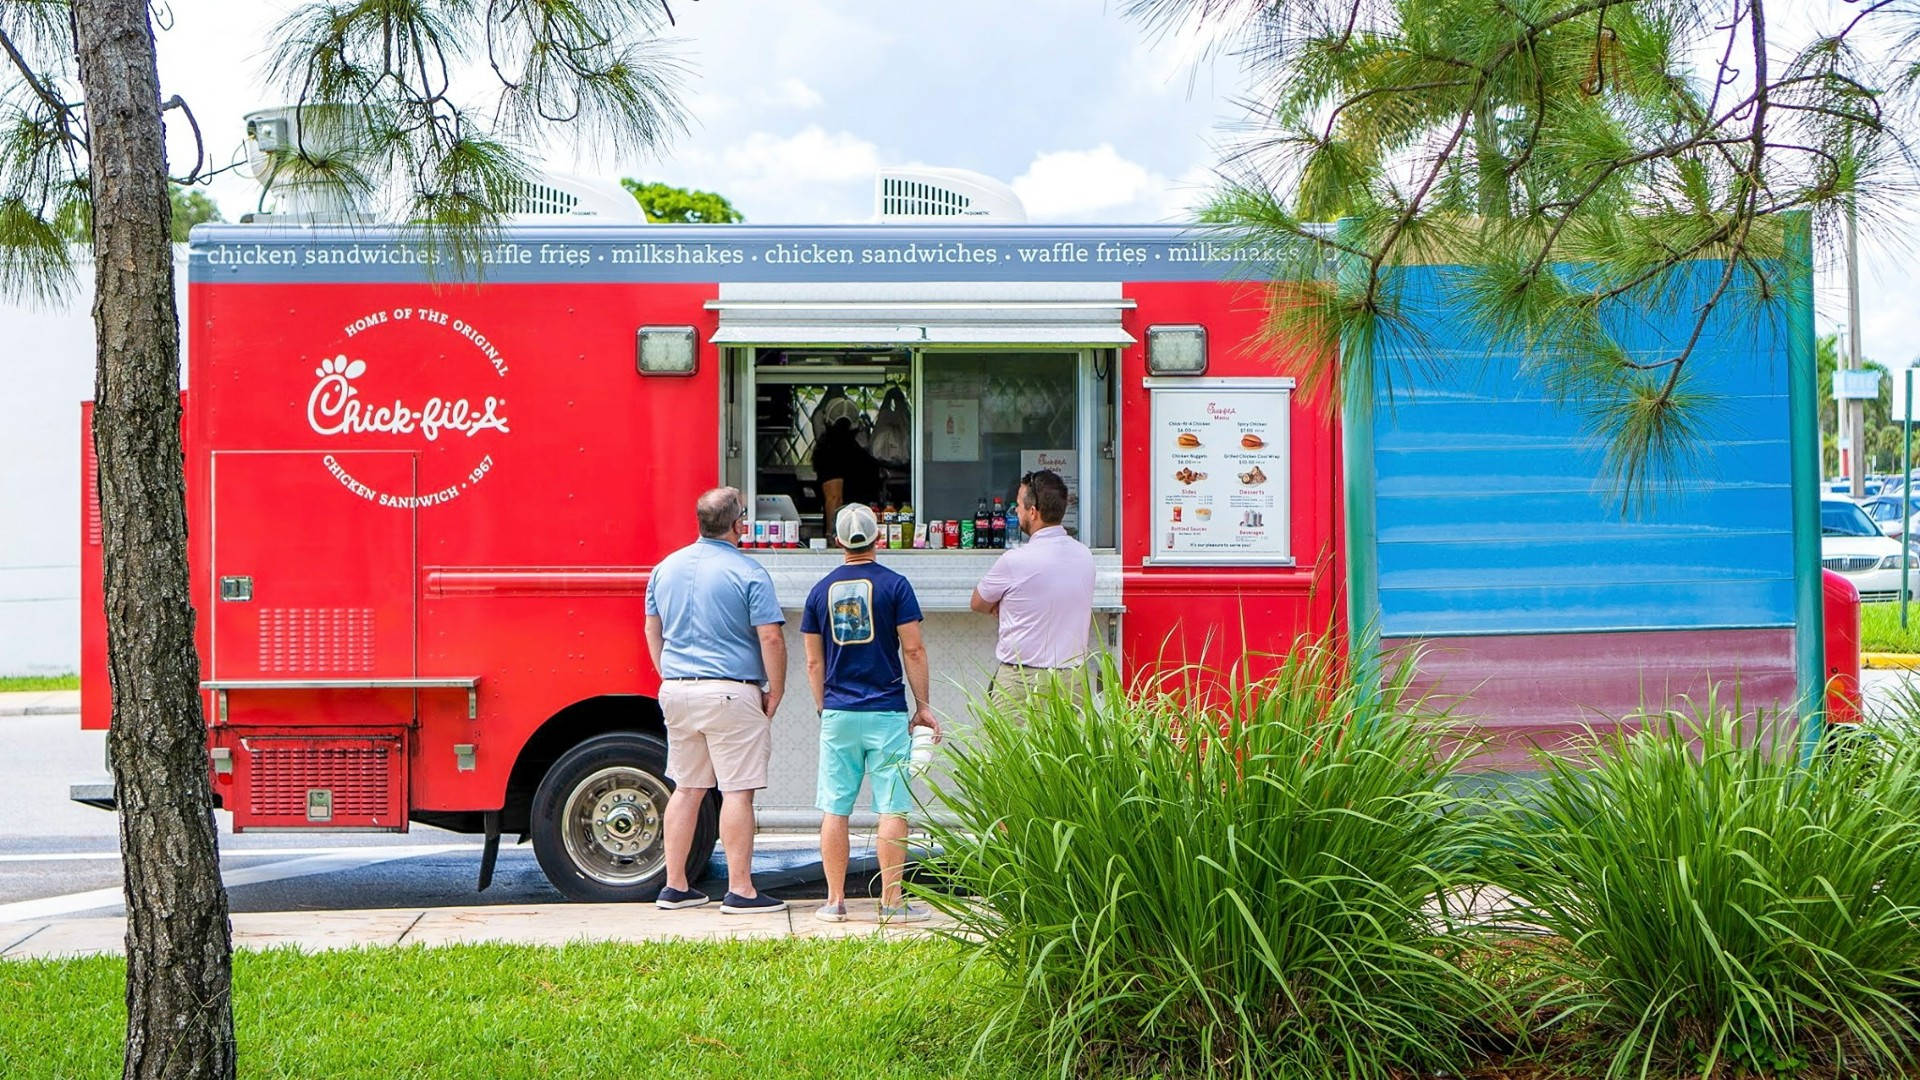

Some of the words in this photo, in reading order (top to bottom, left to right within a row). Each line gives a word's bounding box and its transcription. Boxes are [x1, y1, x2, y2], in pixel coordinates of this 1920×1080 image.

[207, 244, 298, 265] chicken
[305, 244, 441, 265] sandwiches
[462, 244, 533, 264] waffle
[539, 244, 591, 264] fries
[611, 244, 744, 264] milkshakes
[765, 244, 854, 264] chicken
[861, 243, 998, 264] sandwiches
[1018, 242, 1089, 263] waffle
[1096, 242, 1147, 263] fries
[344, 311, 388, 338] HOME
[393, 308, 413, 320] OF
[418, 309, 449, 326] THE
[452, 319, 510, 377] ORIGINAL
[323, 454, 377, 501] CHICKEN
[378, 485, 460, 509] SANDWICH
[468, 454, 495, 485] 1967
